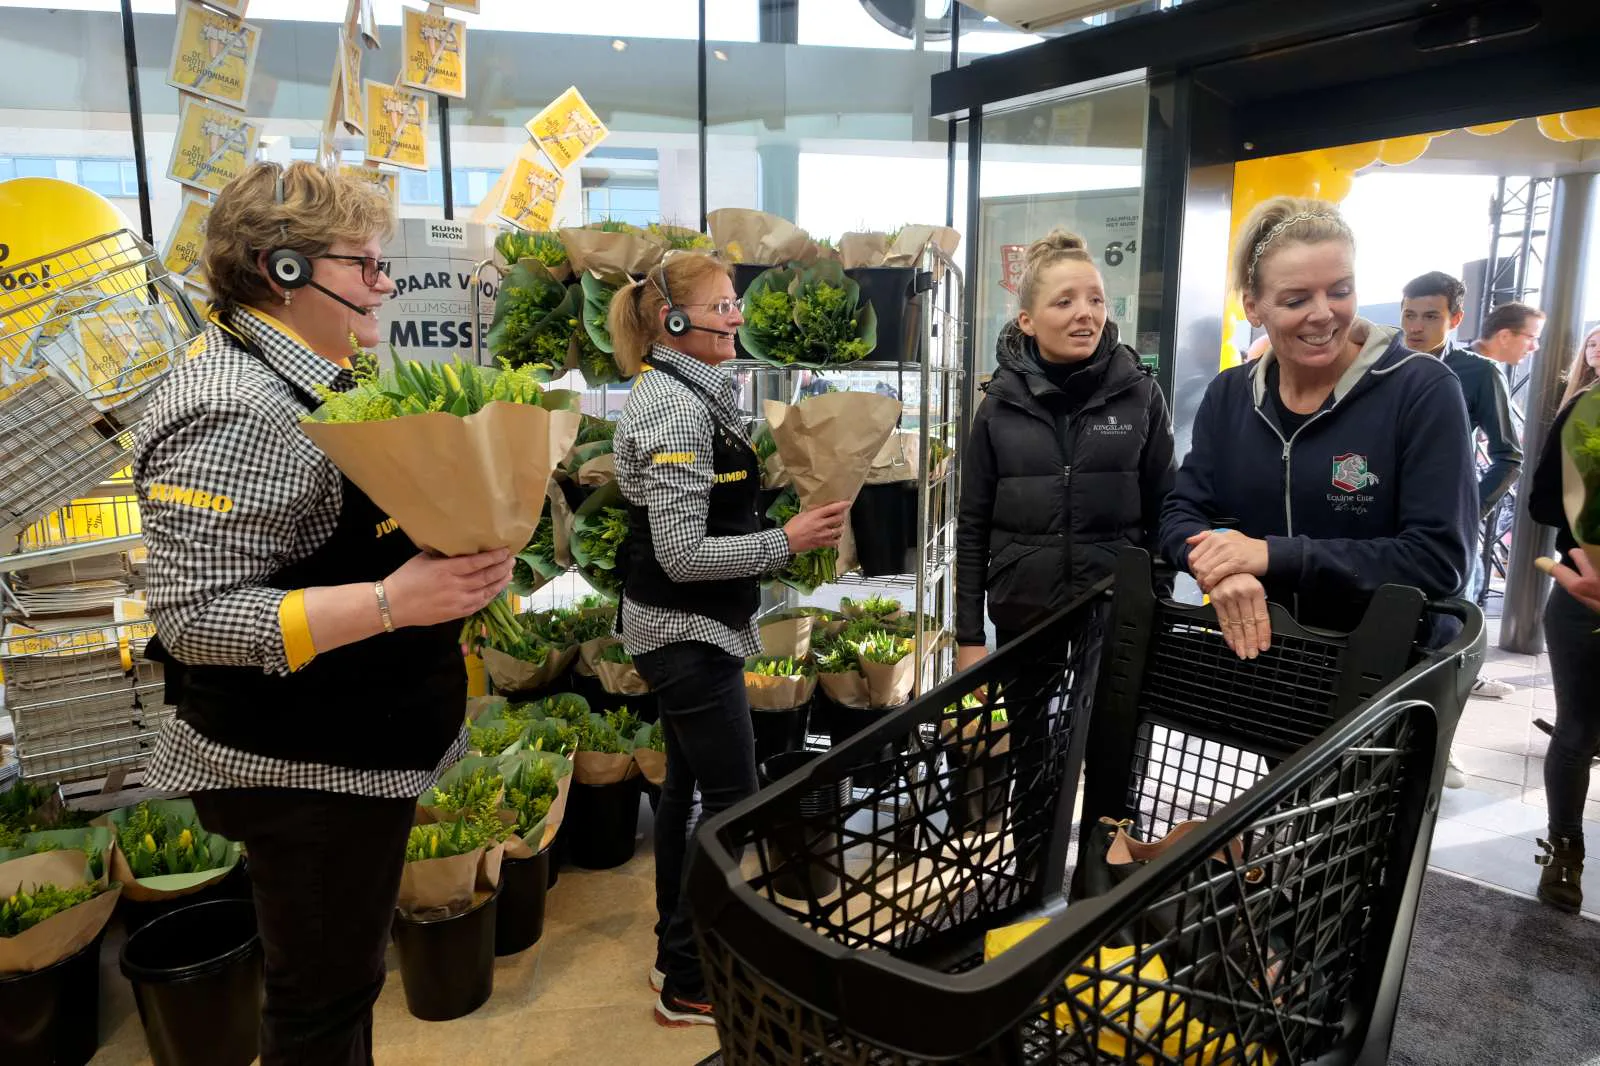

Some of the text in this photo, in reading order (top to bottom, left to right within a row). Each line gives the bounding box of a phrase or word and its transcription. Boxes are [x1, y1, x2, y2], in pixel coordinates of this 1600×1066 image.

[431, 224, 463, 233] KUHN
[431, 232, 463, 241] RIKON
[390, 320, 490, 348] MESSE
[652, 451, 695, 464] JUMBO
[712, 470, 747, 484] JUMBO
[148, 483, 233, 513] JUMBO
